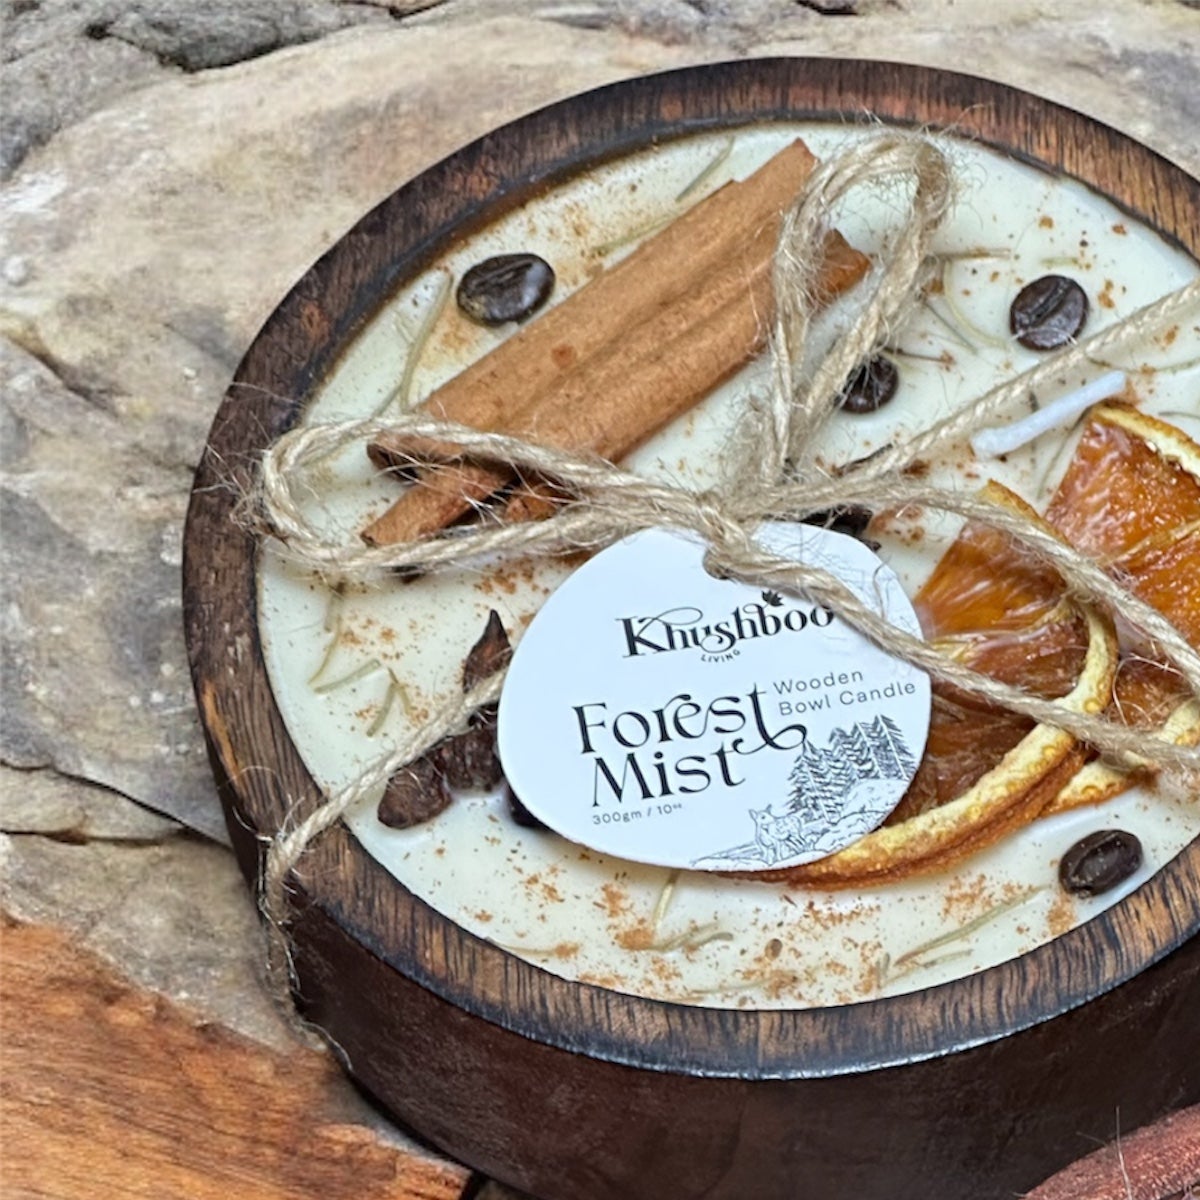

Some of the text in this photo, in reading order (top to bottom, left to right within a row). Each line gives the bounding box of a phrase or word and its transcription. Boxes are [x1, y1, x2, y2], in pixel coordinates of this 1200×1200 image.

[615, 600, 835, 658] Khushboo
[700, 648, 741, 663] LIVING
[773, 669, 864, 696] Wooden
[778, 679, 917, 717] Bowl Candle
[571, 682, 807, 755] Forest
[592, 740, 746, 808] Mist
[592, 810, 642, 826] 300gm
